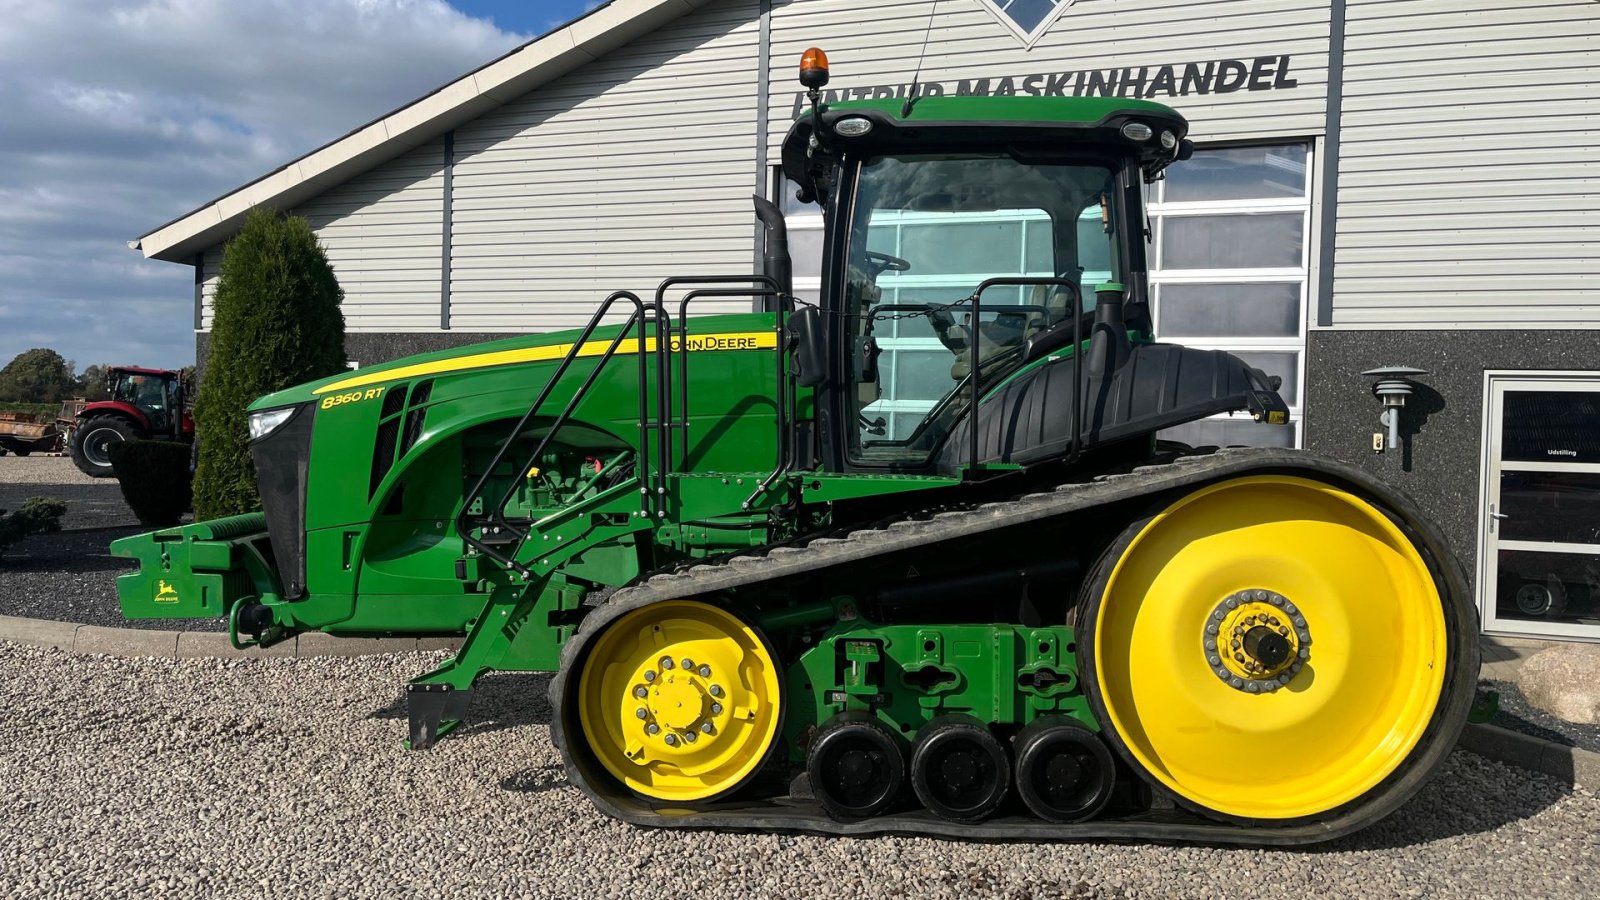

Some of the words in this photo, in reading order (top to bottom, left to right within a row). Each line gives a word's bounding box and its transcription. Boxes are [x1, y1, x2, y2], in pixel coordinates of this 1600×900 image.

[955, 55, 1297, 99] MASKINHANDEL
[670, 340, 702, 350] OHN
[705, 337, 757, 349] DEERE
[321, 391, 363, 409] 8360
[364, 386, 385, 400] RT
[1547, 449, 1577, 457] Udstilling
